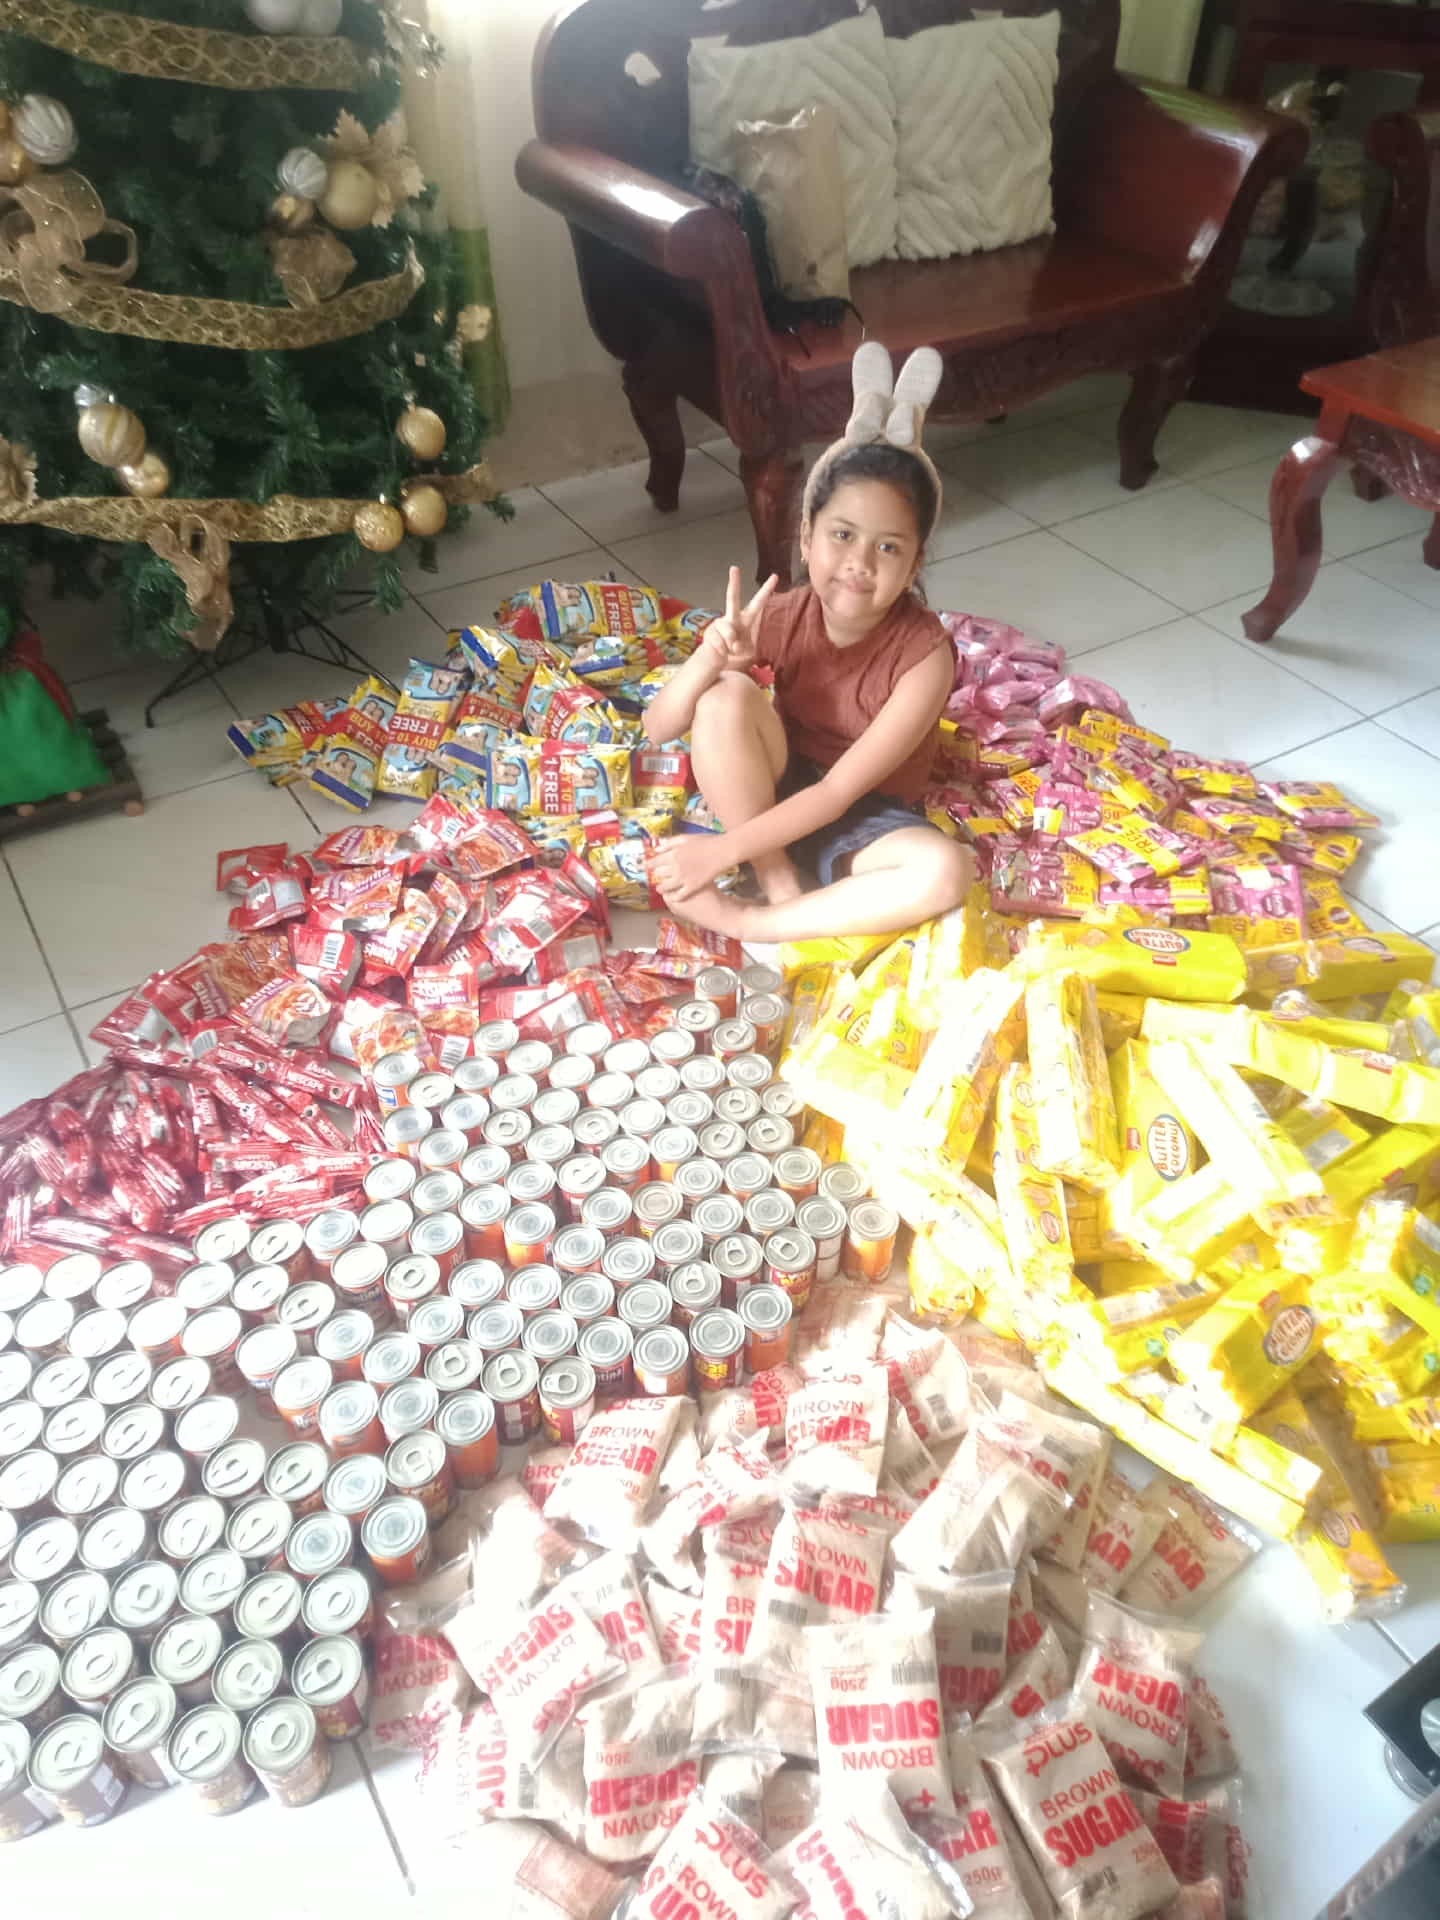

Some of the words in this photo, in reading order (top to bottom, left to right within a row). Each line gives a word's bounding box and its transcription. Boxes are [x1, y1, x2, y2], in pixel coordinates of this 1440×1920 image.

[391, 715, 428, 735] FREE
[432, 722, 440, 736] 1
[412, 735, 438, 749] BUY
[544, 777, 560, 813] FREE
[1135, 936, 1185, 951] BUTTER
[1151, 1120, 1169, 1170] BUTTER
[791, 1400, 864, 1419] BROWN
[588, 1425, 656, 1441] BROWN
[792, 1535, 867, 1577] BROWN
[774, 1558, 876, 1616] SUGAR
[825, 1698, 941, 1746] SUGAR
[1097, 1690, 1180, 1746] BROWN
[842, 1745, 935, 1772] BROWN
[1039, 1767, 1118, 1821] BROWN
